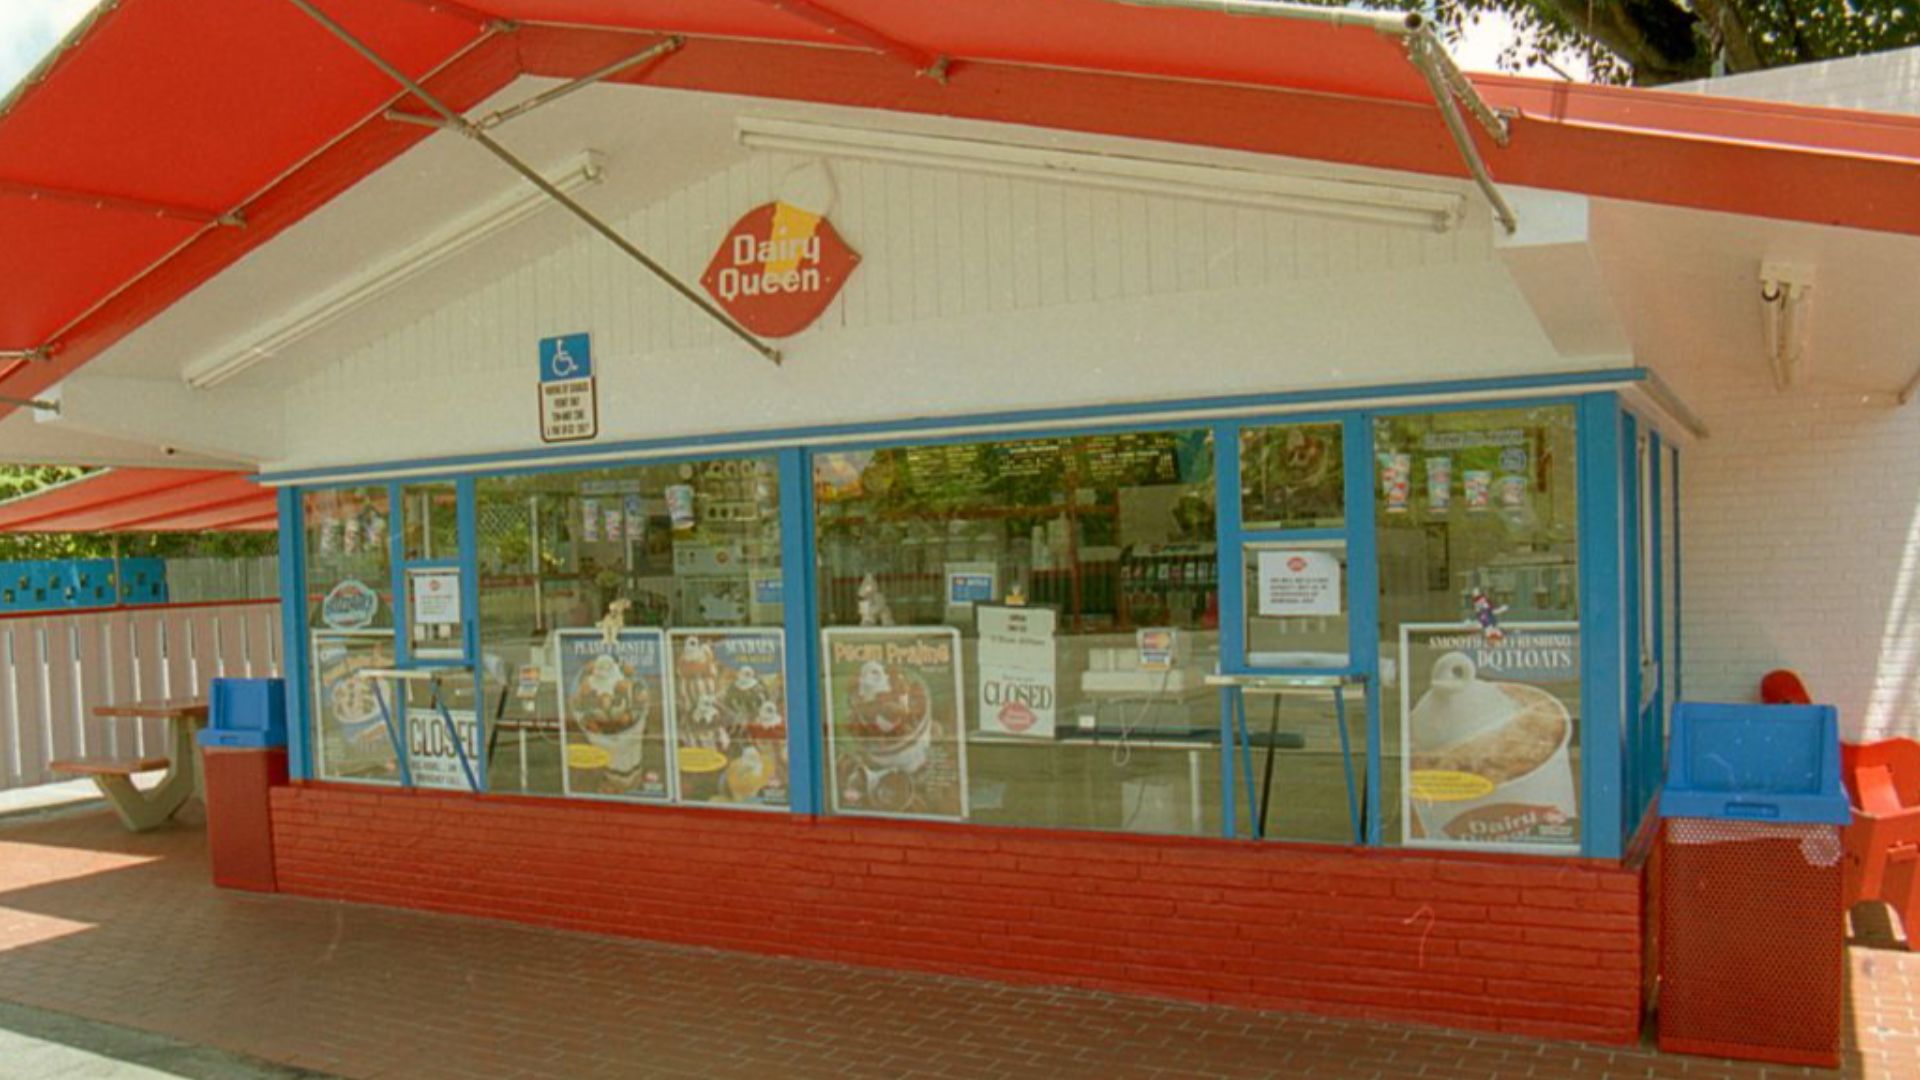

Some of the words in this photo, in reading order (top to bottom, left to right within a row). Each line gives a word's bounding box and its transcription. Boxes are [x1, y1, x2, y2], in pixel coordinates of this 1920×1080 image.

[733, 234, 820, 266] Dairy
[719, 267, 820, 301] Queen
[983, 680, 1052, 710] CLOSED
